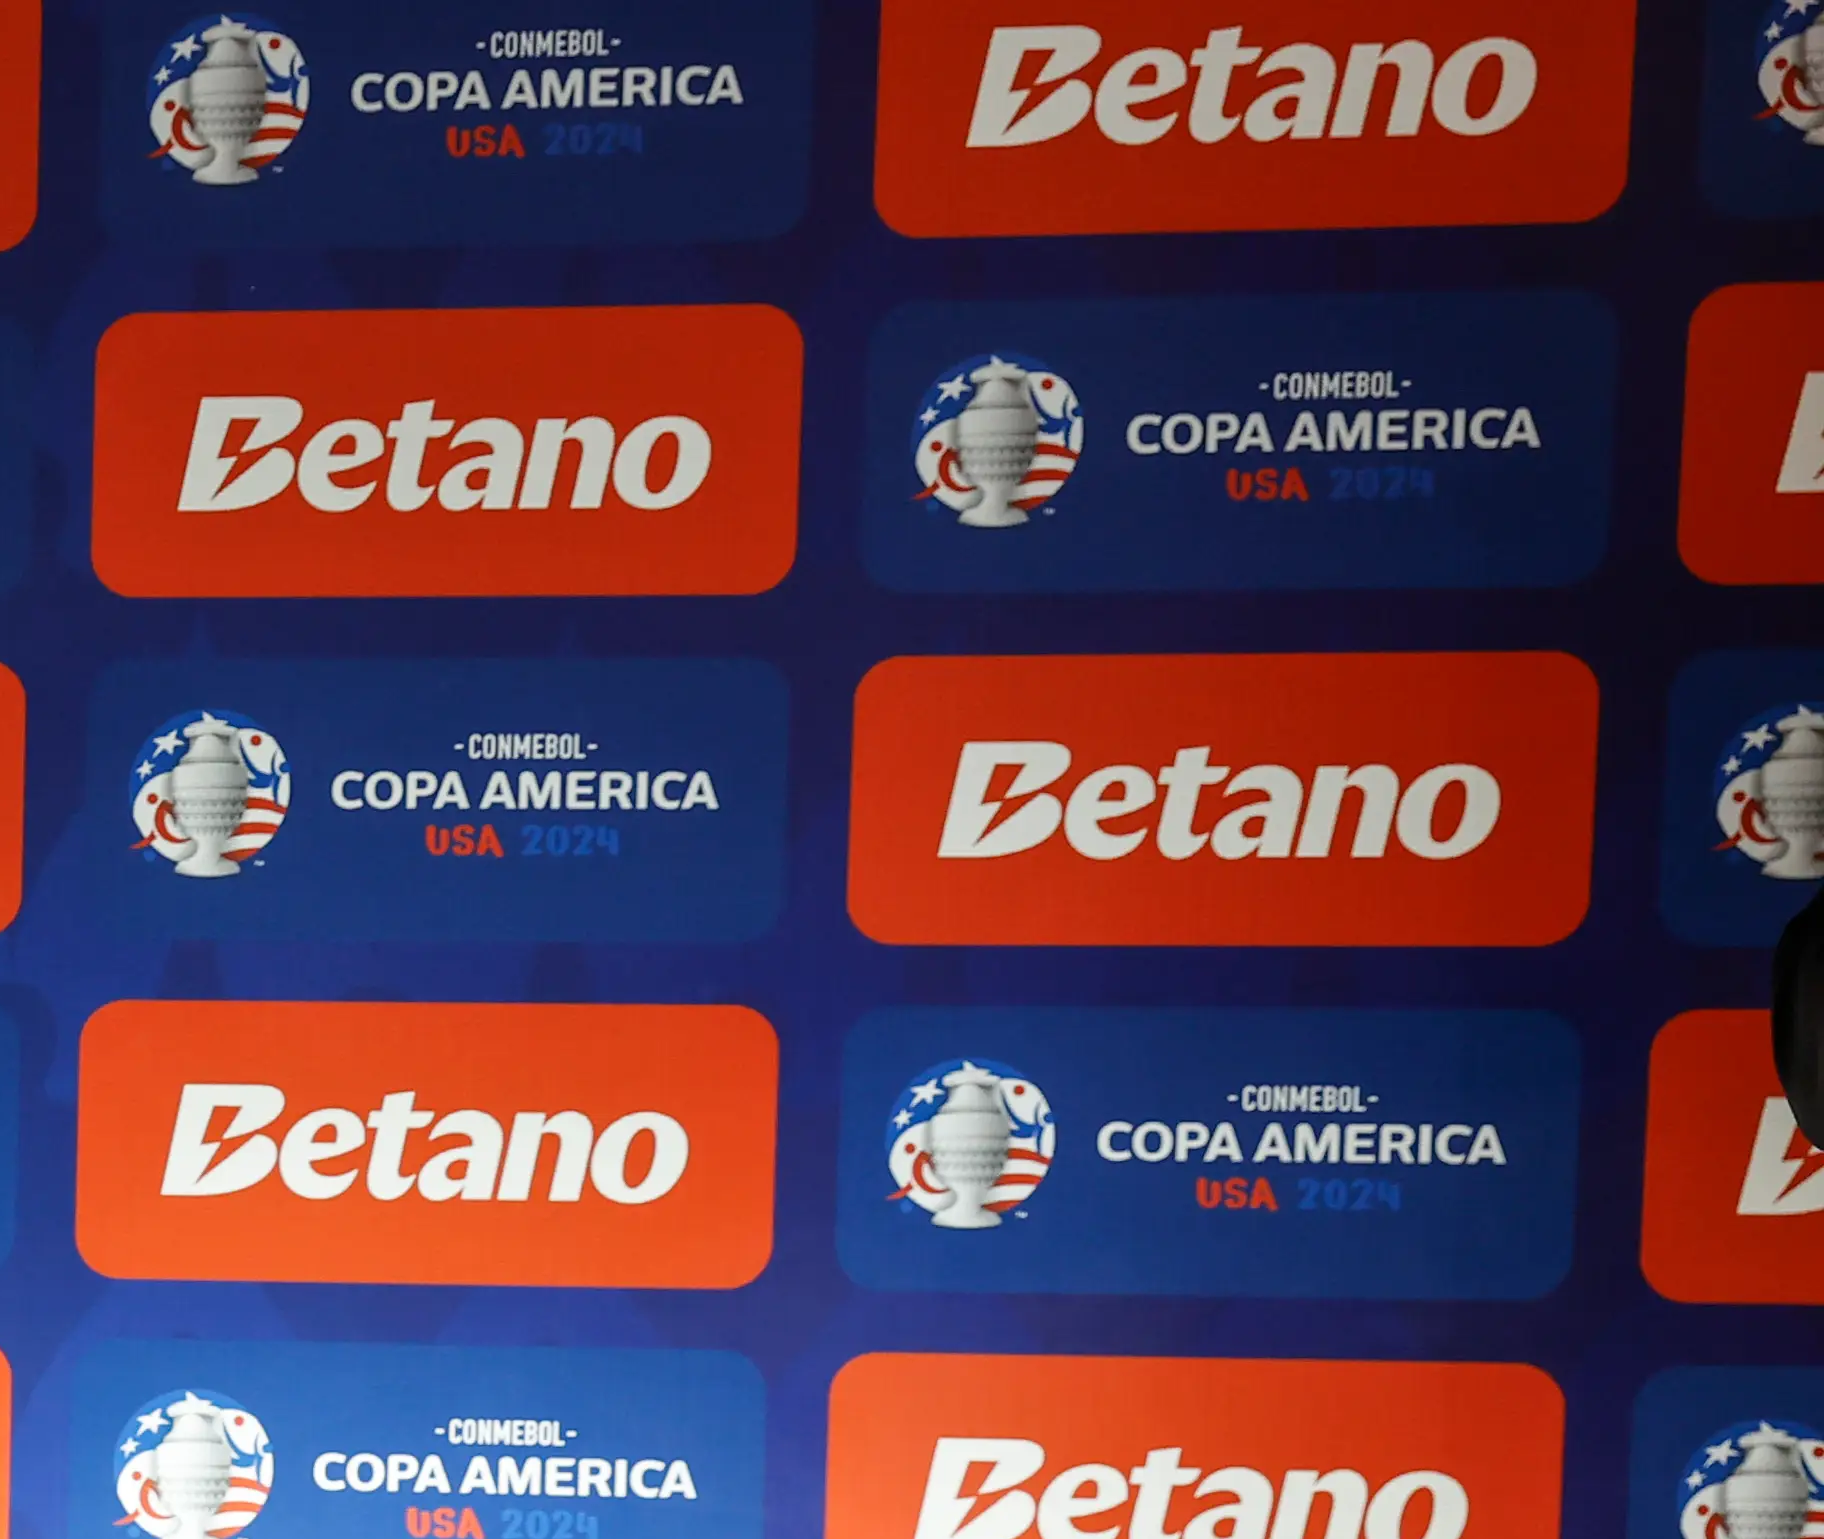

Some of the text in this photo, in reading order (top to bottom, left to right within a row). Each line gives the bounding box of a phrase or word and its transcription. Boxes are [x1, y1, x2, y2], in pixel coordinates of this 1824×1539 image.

[352, 65, 743, 111] COPA AMERICA
[967, 26, 1536, 147] Betano
[447, 125, 525, 157] USA
[1127, 408, 1540, 454] COPA AMERICA
[178, 397, 711, 511] Betano
[1227, 468, 1309, 500] USA
[332, 771, 718, 809] COPA AMERICA
[938, 742, 1499, 859] Betano
[427, 825, 619, 856] USA 2024
[161, 1084, 688, 1203] Betano
[1098, 1122, 1505, 1164] COPA AMERICA
[1197, 1178, 1400, 1210] USA 2024
[313, 1453, 696, 1499] COPA AMERICA
[408, 1508, 483, 1539] USA
